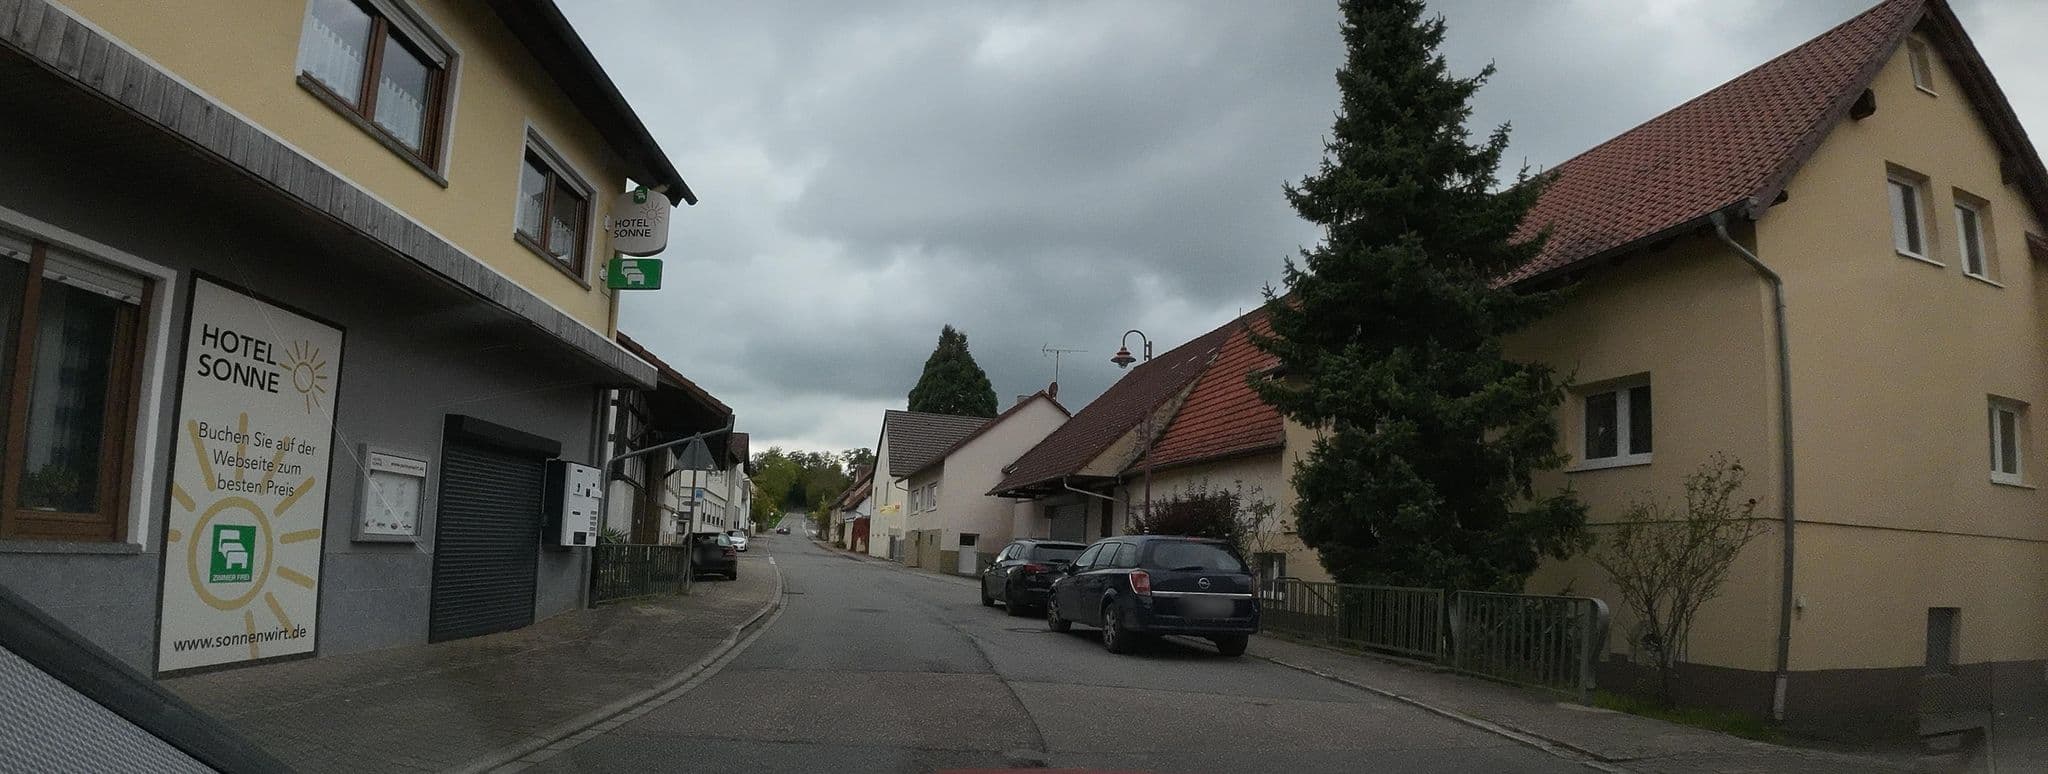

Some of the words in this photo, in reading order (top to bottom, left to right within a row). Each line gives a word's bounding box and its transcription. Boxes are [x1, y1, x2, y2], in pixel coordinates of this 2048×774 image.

[615, 219, 649, 228] HOTEL
[615, 229, 651, 238] SONNE
[201, 323, 277, 366] HOTEL
[197, 355, 280, 394] SONNE
[198, 422, 250, 445] Buchen
[254, 433, 273, 448] Sie
[276, 436, 296, 452] auf
[298, 440, 317, 456] der
[213, 449, 274, 471] Webseite
[277, 461, 302, 475] zum
[217, 472, 262, 494] besten
[266, 482, 295, 497] Preis
[174, 624, 307, 652] www.sonnenwirt.de
